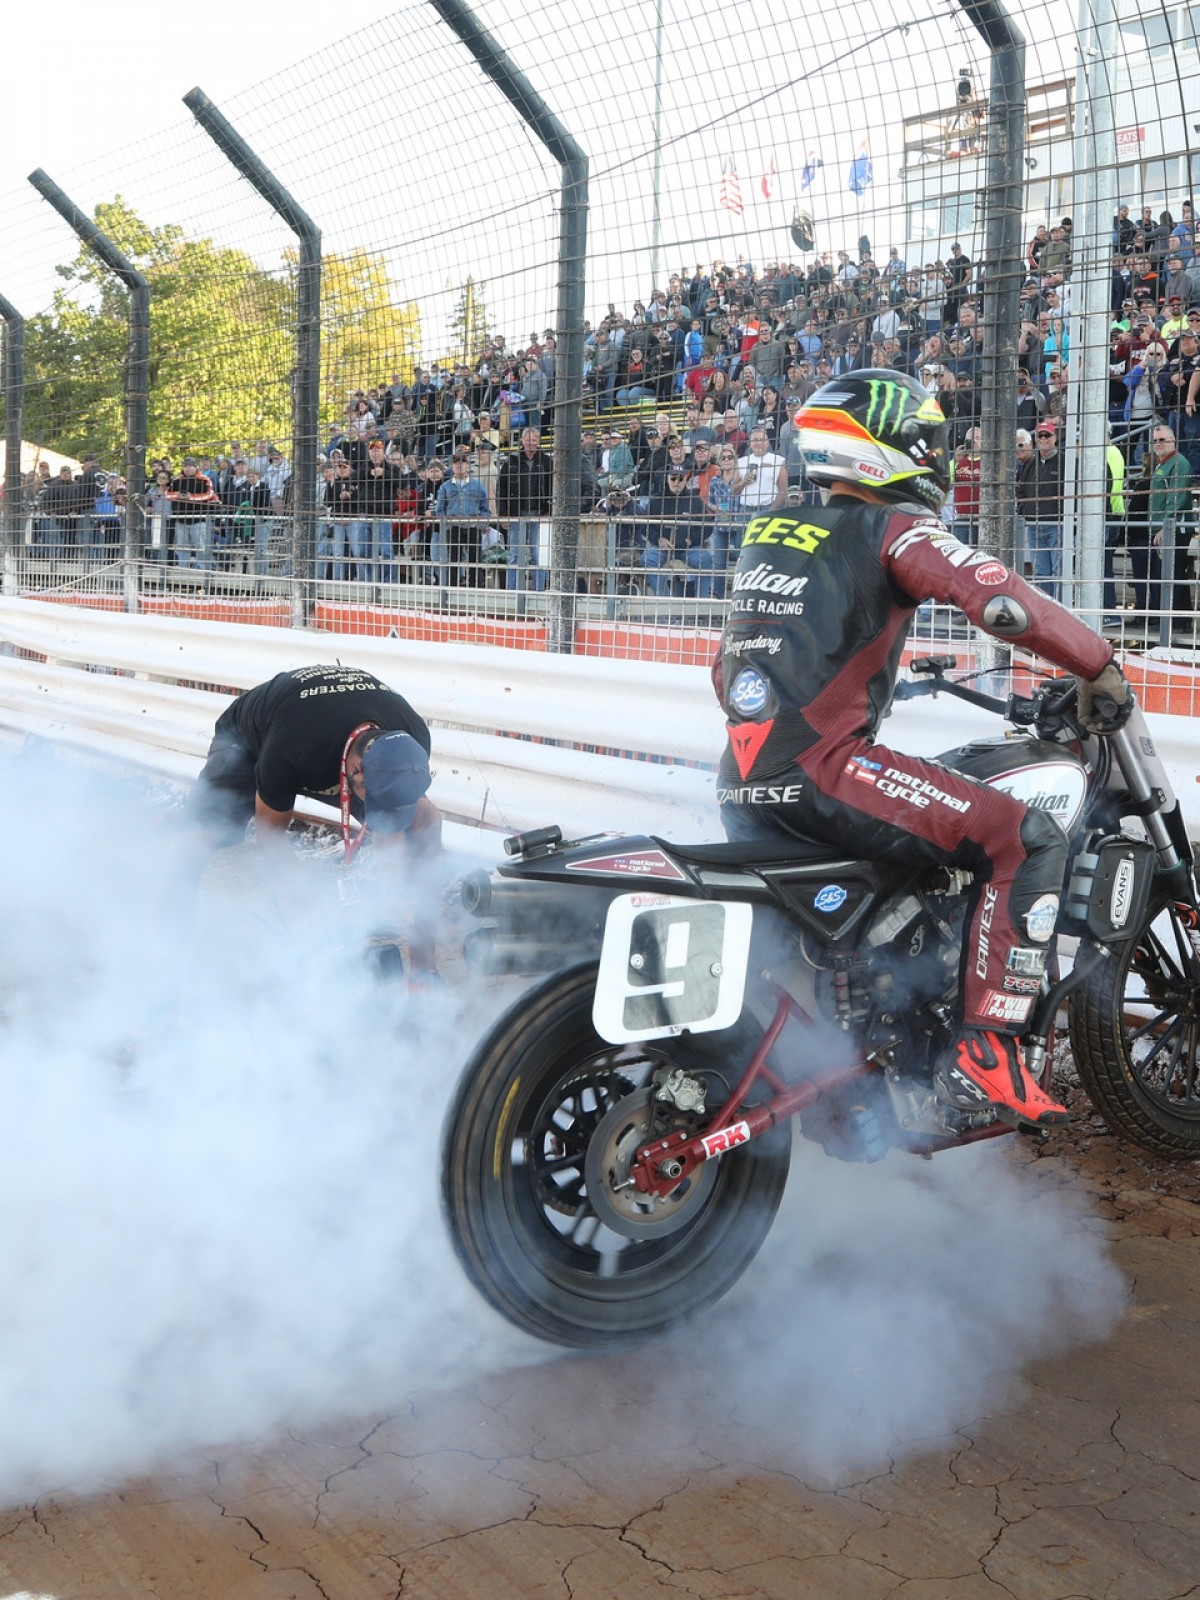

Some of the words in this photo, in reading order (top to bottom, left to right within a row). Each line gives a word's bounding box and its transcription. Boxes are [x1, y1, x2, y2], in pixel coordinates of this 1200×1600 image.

[1117, 131, 1138, 144] EATS
[858, 463, 886, 479] BELL
[733, 563, 809, 597] ndian
[731, 599, 755, 612] CLE
[758, 600, 804, 615] RACING
[300, 683, 376, 699] ROASTERS
[735, 679, 765, 702] S&S
[876, 778, 930, 809] cycle
[883, 767, 972, 814] national
[629, 860, 666, 868] national
[1115, 866, 1128, 919] EVANS
[976, 884, 998, 980] DAINESE
[622, 903, 726, 1031] 9
[993, 994, 1032, 1012] TWIN
[706, 1125, 747, 1156] RK
